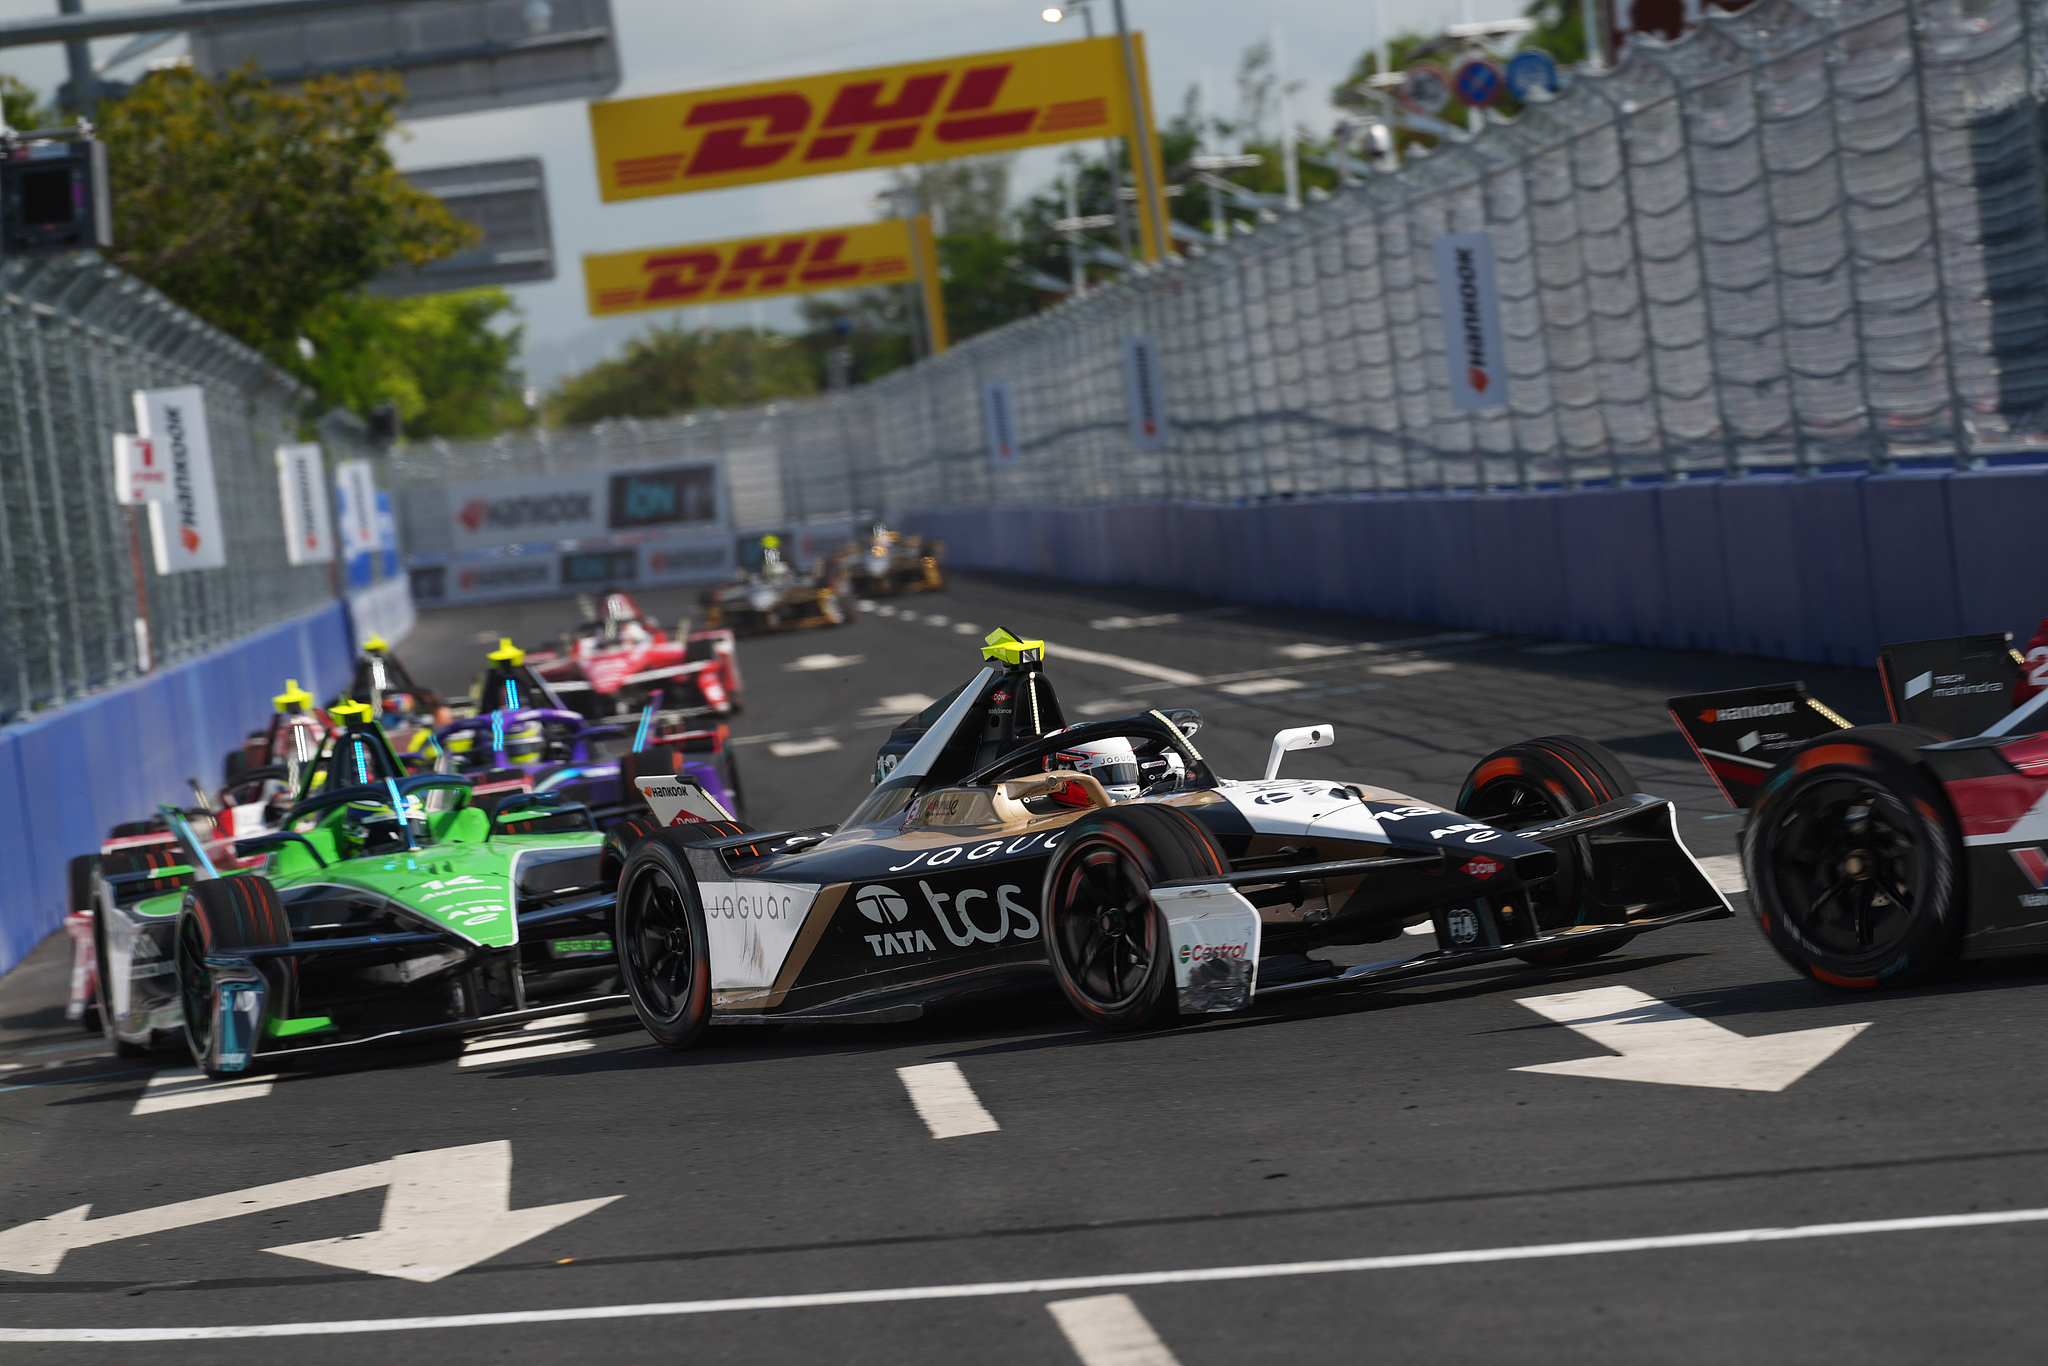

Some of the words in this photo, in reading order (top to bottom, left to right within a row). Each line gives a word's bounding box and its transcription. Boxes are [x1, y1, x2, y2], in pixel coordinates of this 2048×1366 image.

[683, 63, 1039, 178] DHL
[642, 235, 863, 300] DHL
[1932, 681, 2003, 697] mahindra
[1370, 806, 1442, 822] 13
[918, 880, 1040, 947] tcs
[864, 930, 937, 957] TATA
